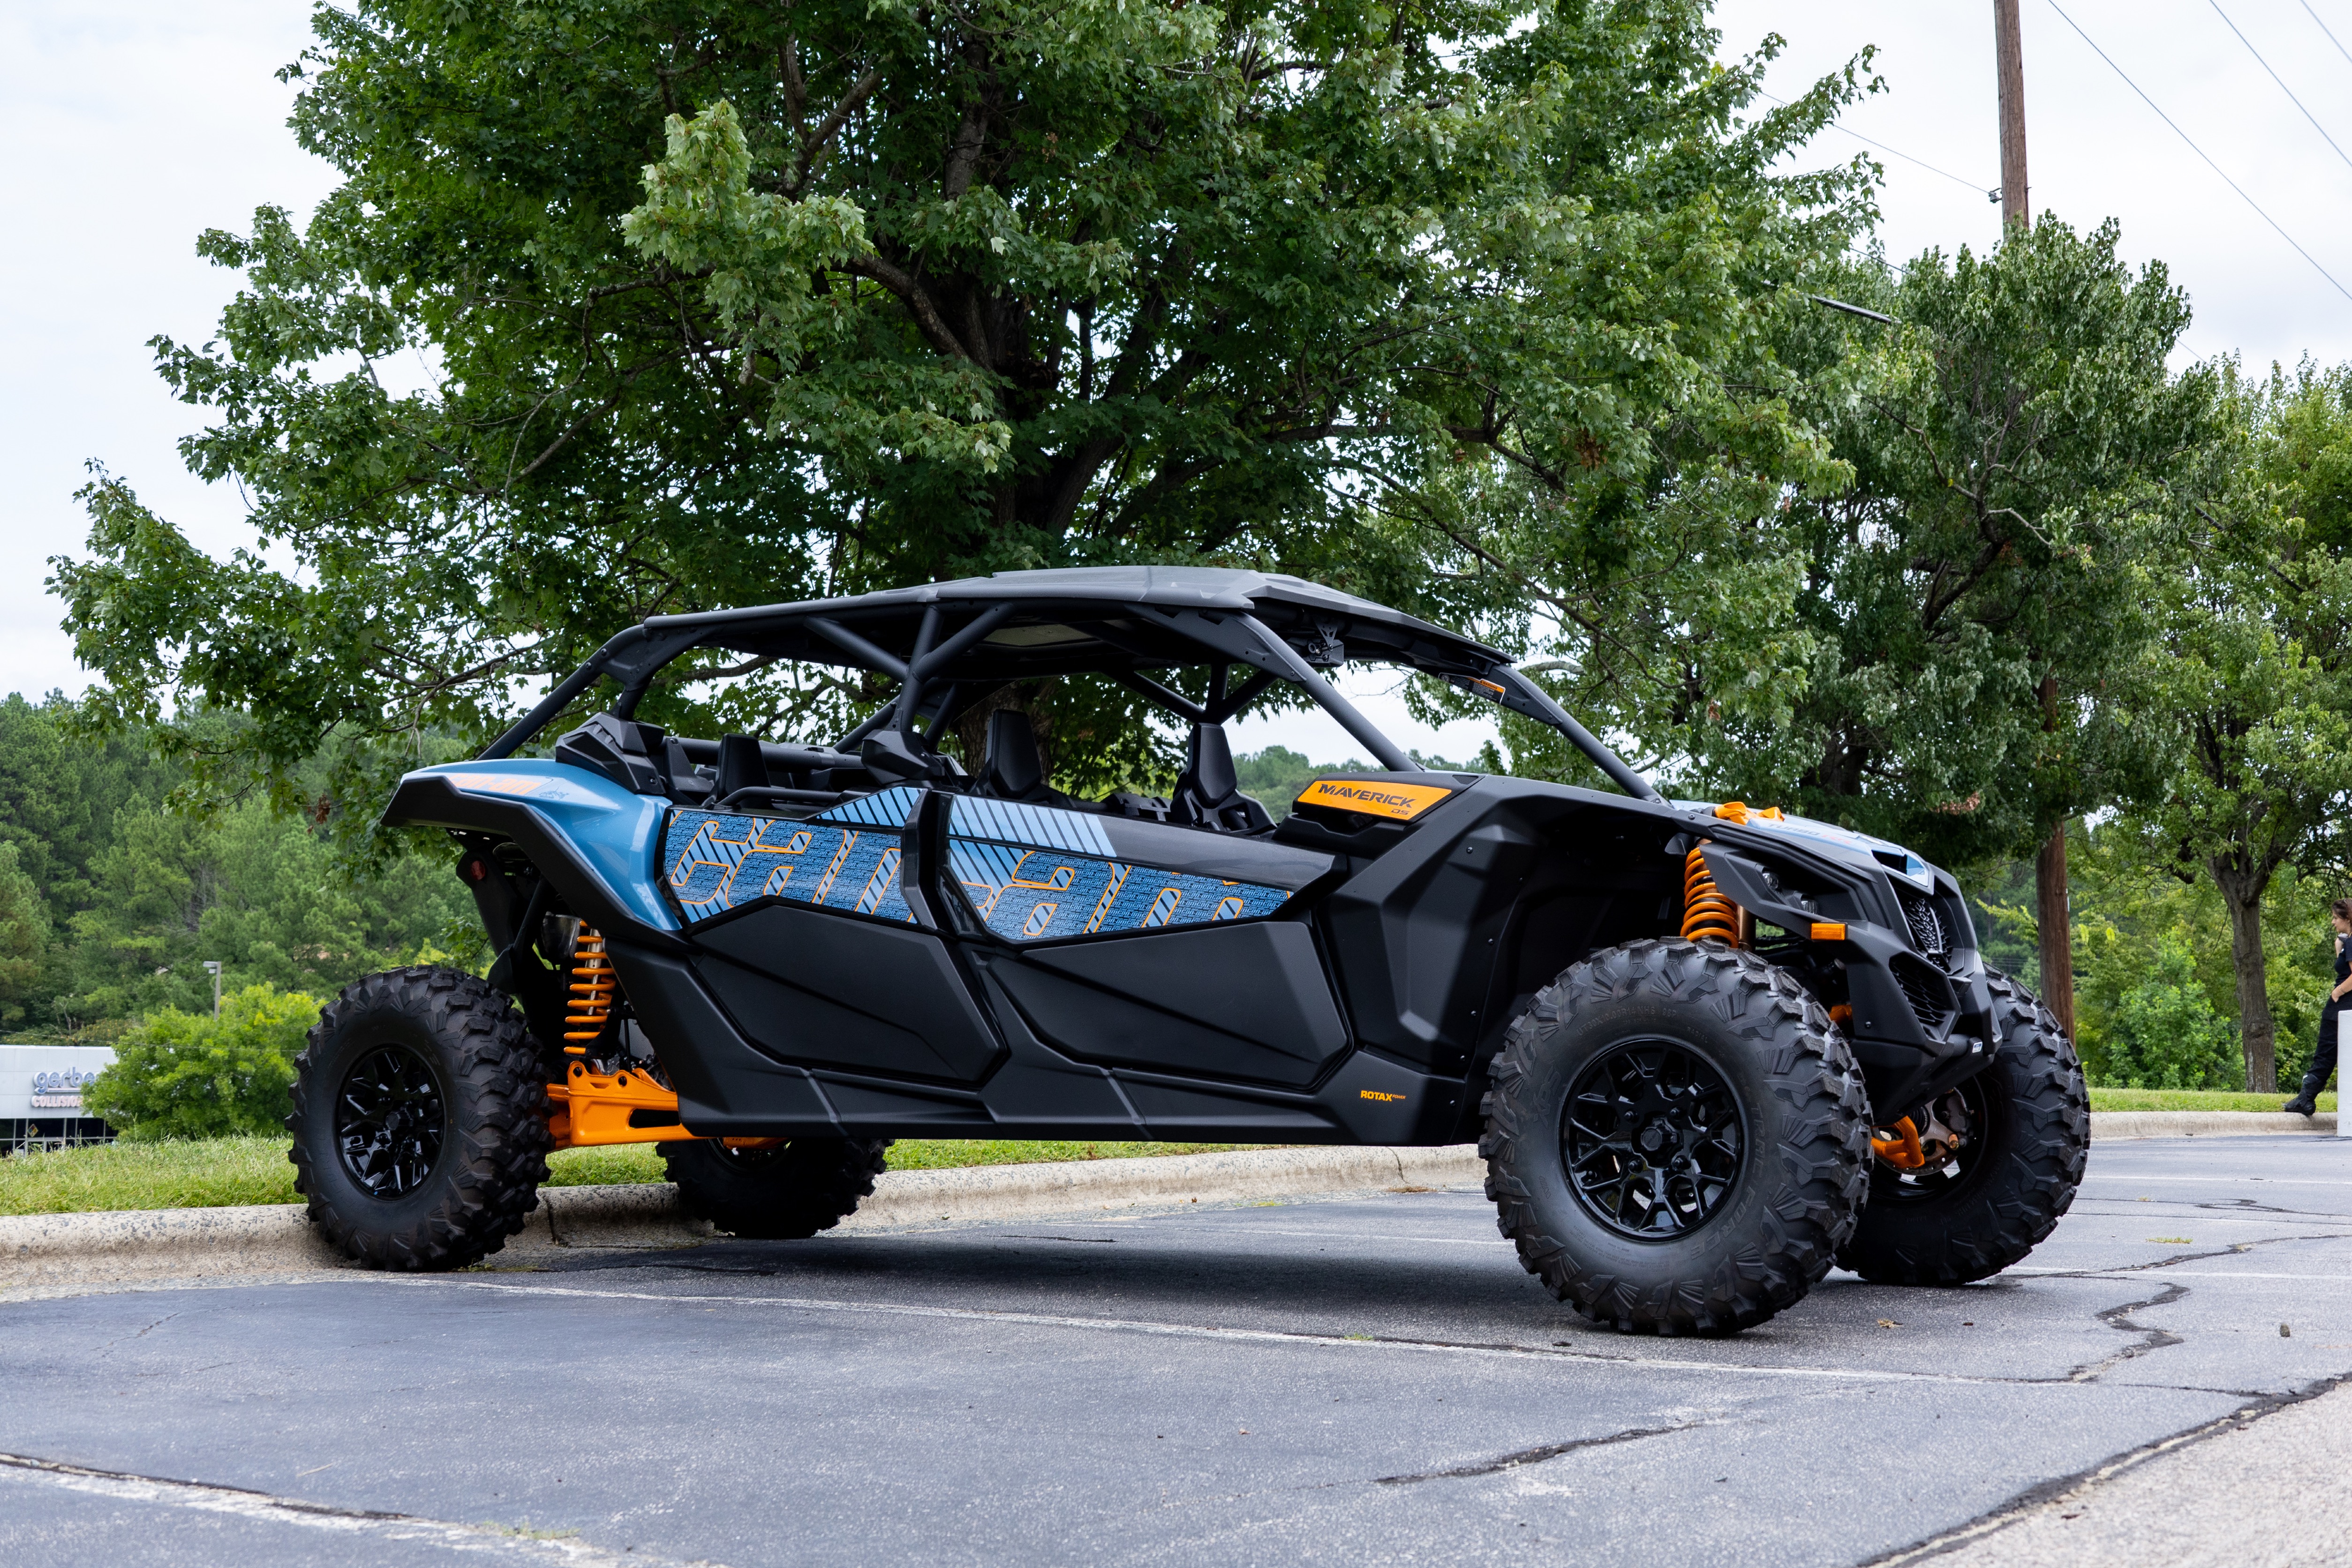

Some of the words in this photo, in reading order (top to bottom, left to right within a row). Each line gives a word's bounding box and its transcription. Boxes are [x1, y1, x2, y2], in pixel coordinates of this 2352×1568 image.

[449, 773, 541, 795] can-am
[1318, 784, 1417, 808] MAVERICK
[1769, 824, 1820, 835] TURBO
[34, 1066, 99, 1094] gerbe
[1360, 1090, 1393, 1102] ROTAX
